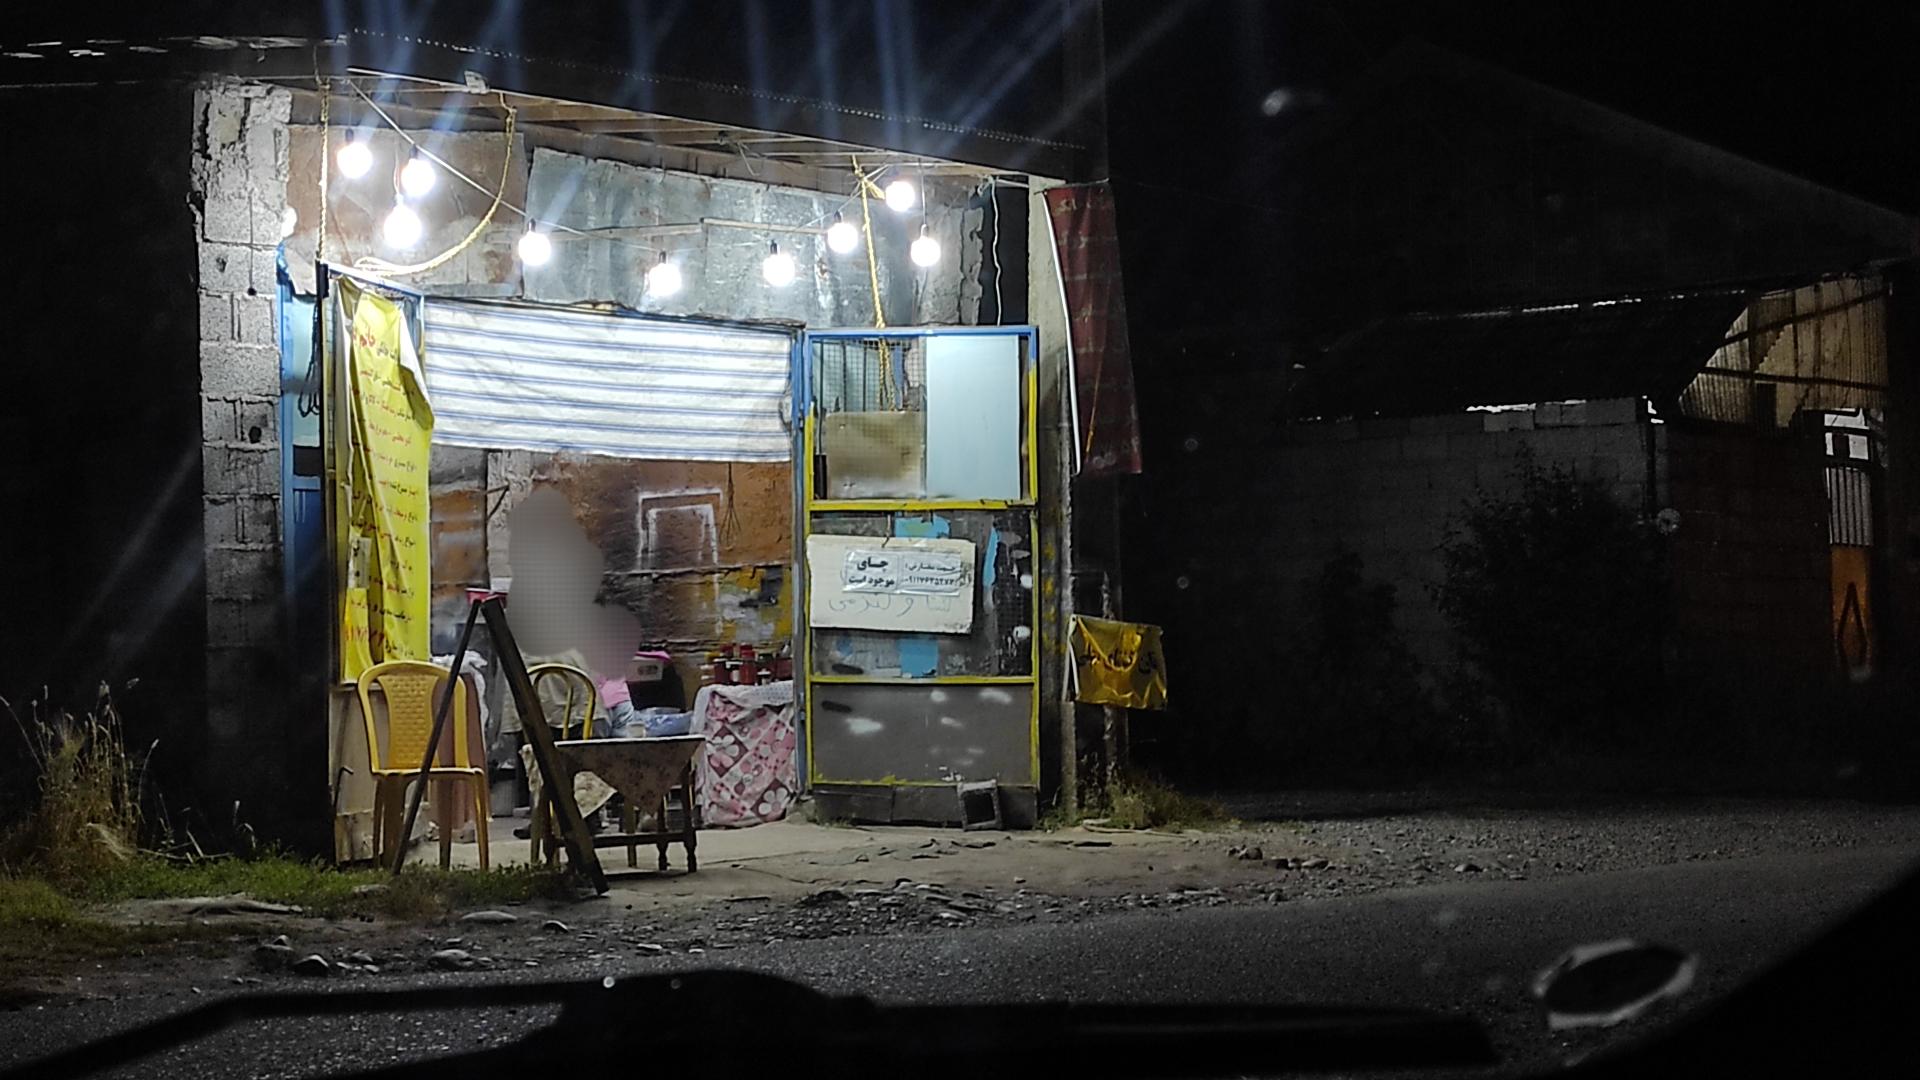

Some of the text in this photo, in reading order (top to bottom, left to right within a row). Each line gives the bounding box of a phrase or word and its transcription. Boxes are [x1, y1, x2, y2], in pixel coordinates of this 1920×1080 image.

[856, 556, 889, 573] چای
[848, 575, 895, 588] موجود است
